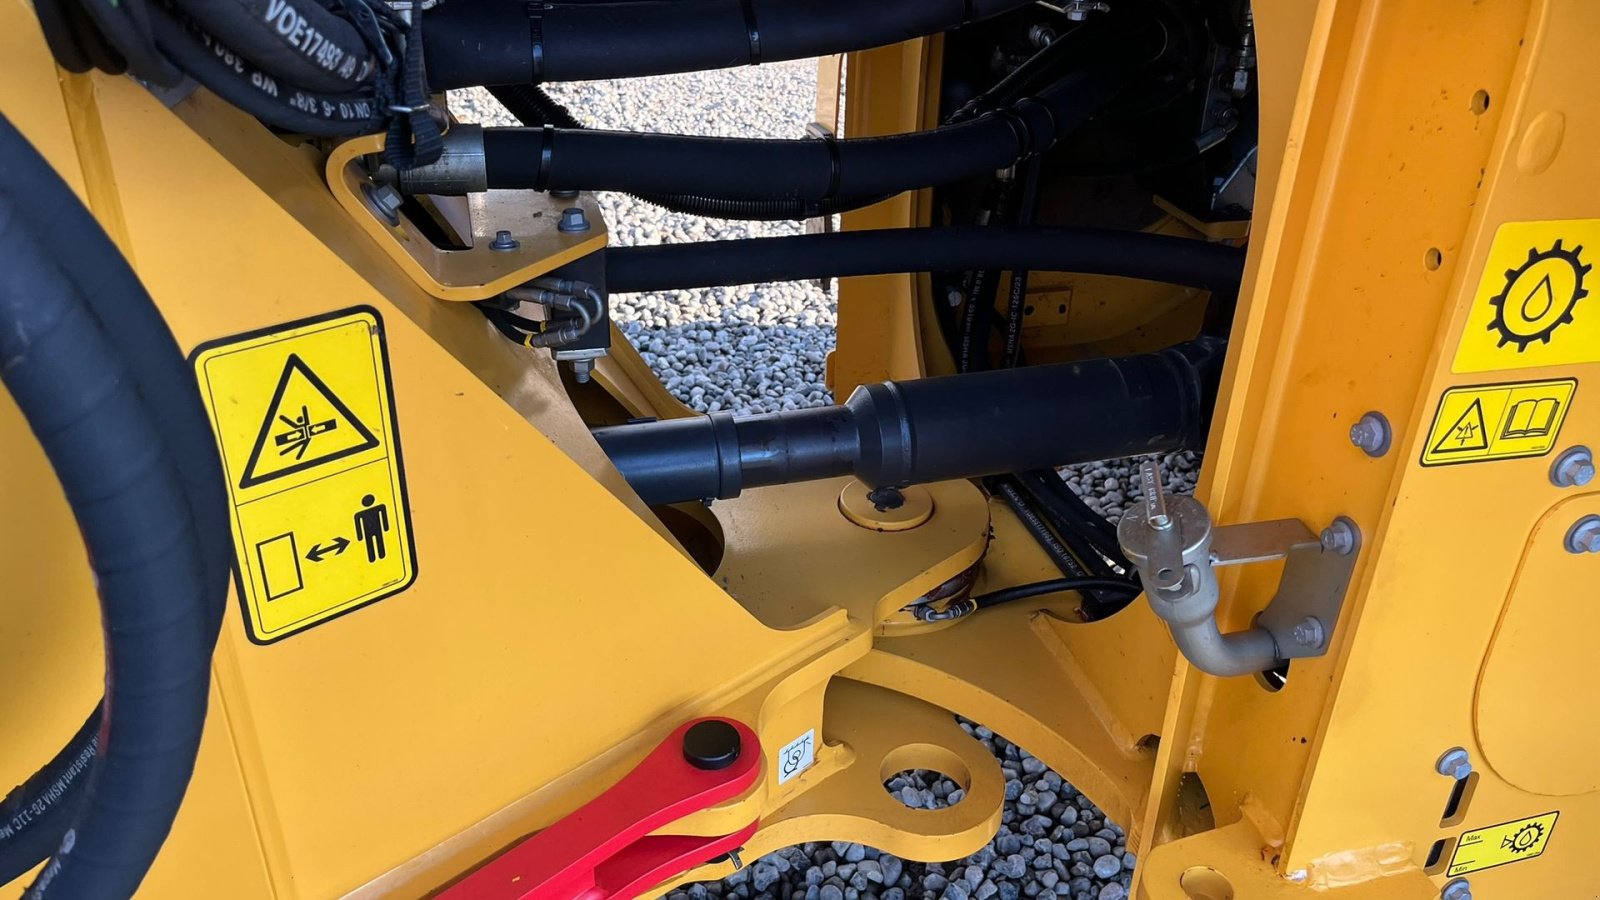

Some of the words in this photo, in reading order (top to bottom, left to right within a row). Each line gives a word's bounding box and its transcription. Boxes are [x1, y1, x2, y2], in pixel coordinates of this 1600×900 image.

[62, 745, 97, 786] Resistant
[44, 778, 68, 805] MSHA
[1466, 834, 1481, 842] Max
